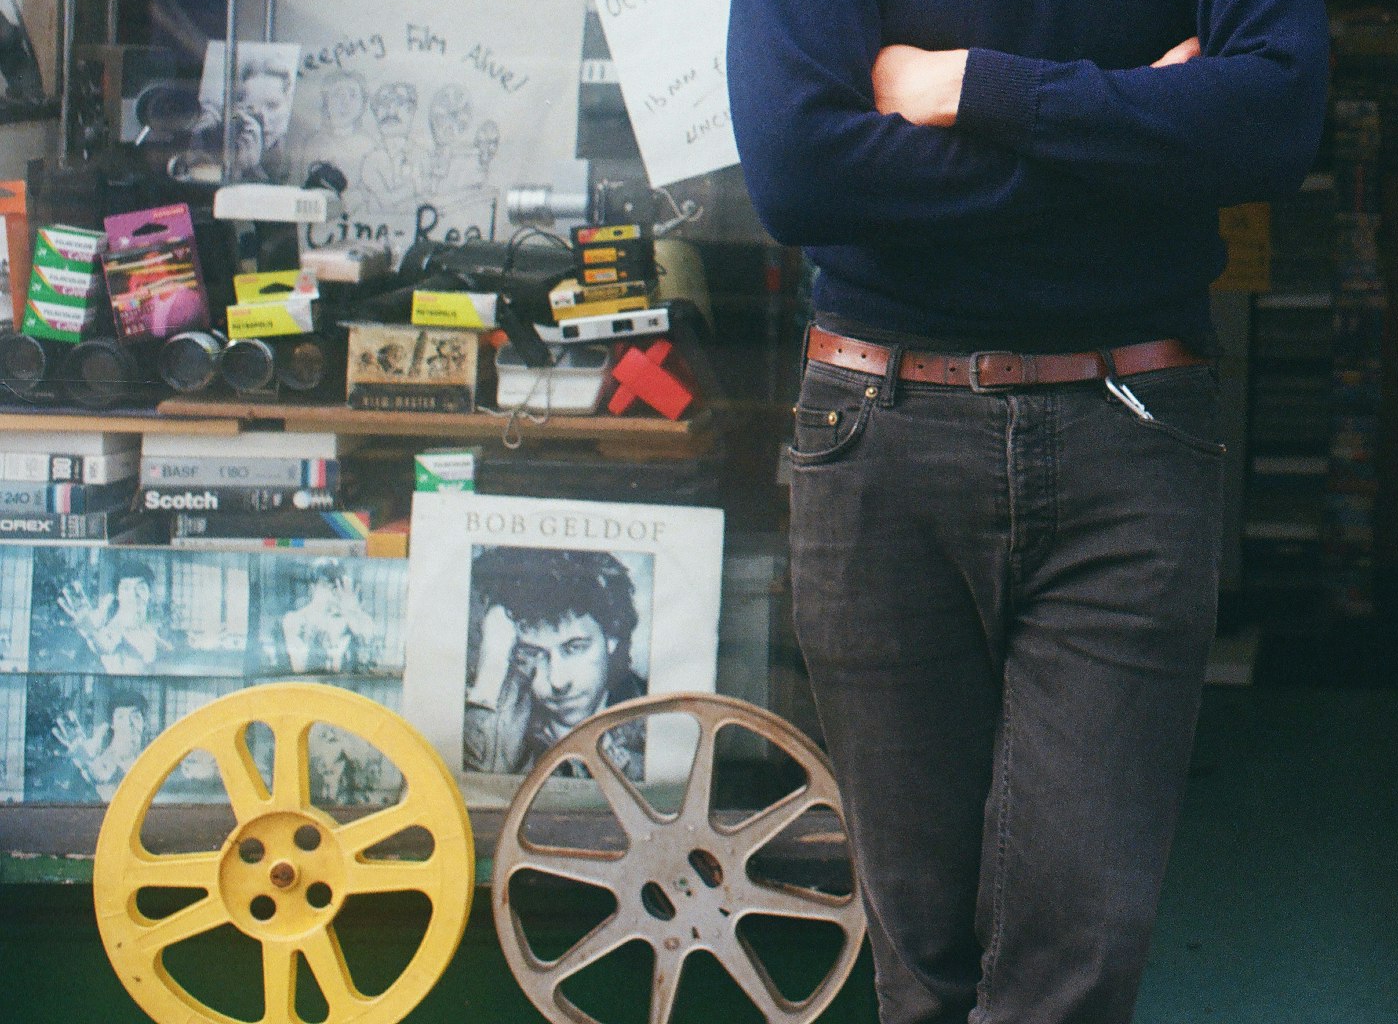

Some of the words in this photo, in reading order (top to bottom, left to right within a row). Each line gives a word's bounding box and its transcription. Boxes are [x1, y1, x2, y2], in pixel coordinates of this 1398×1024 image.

[296, 33, 386, 79] eeping
[406, 23, 447, 55] Film
[161, 464, 200, 478] BASF
[144, 489, 219, 510] Scotch
[465, 511, 528, 534] BOB
[539, 516, 667, 543] GELDOF
